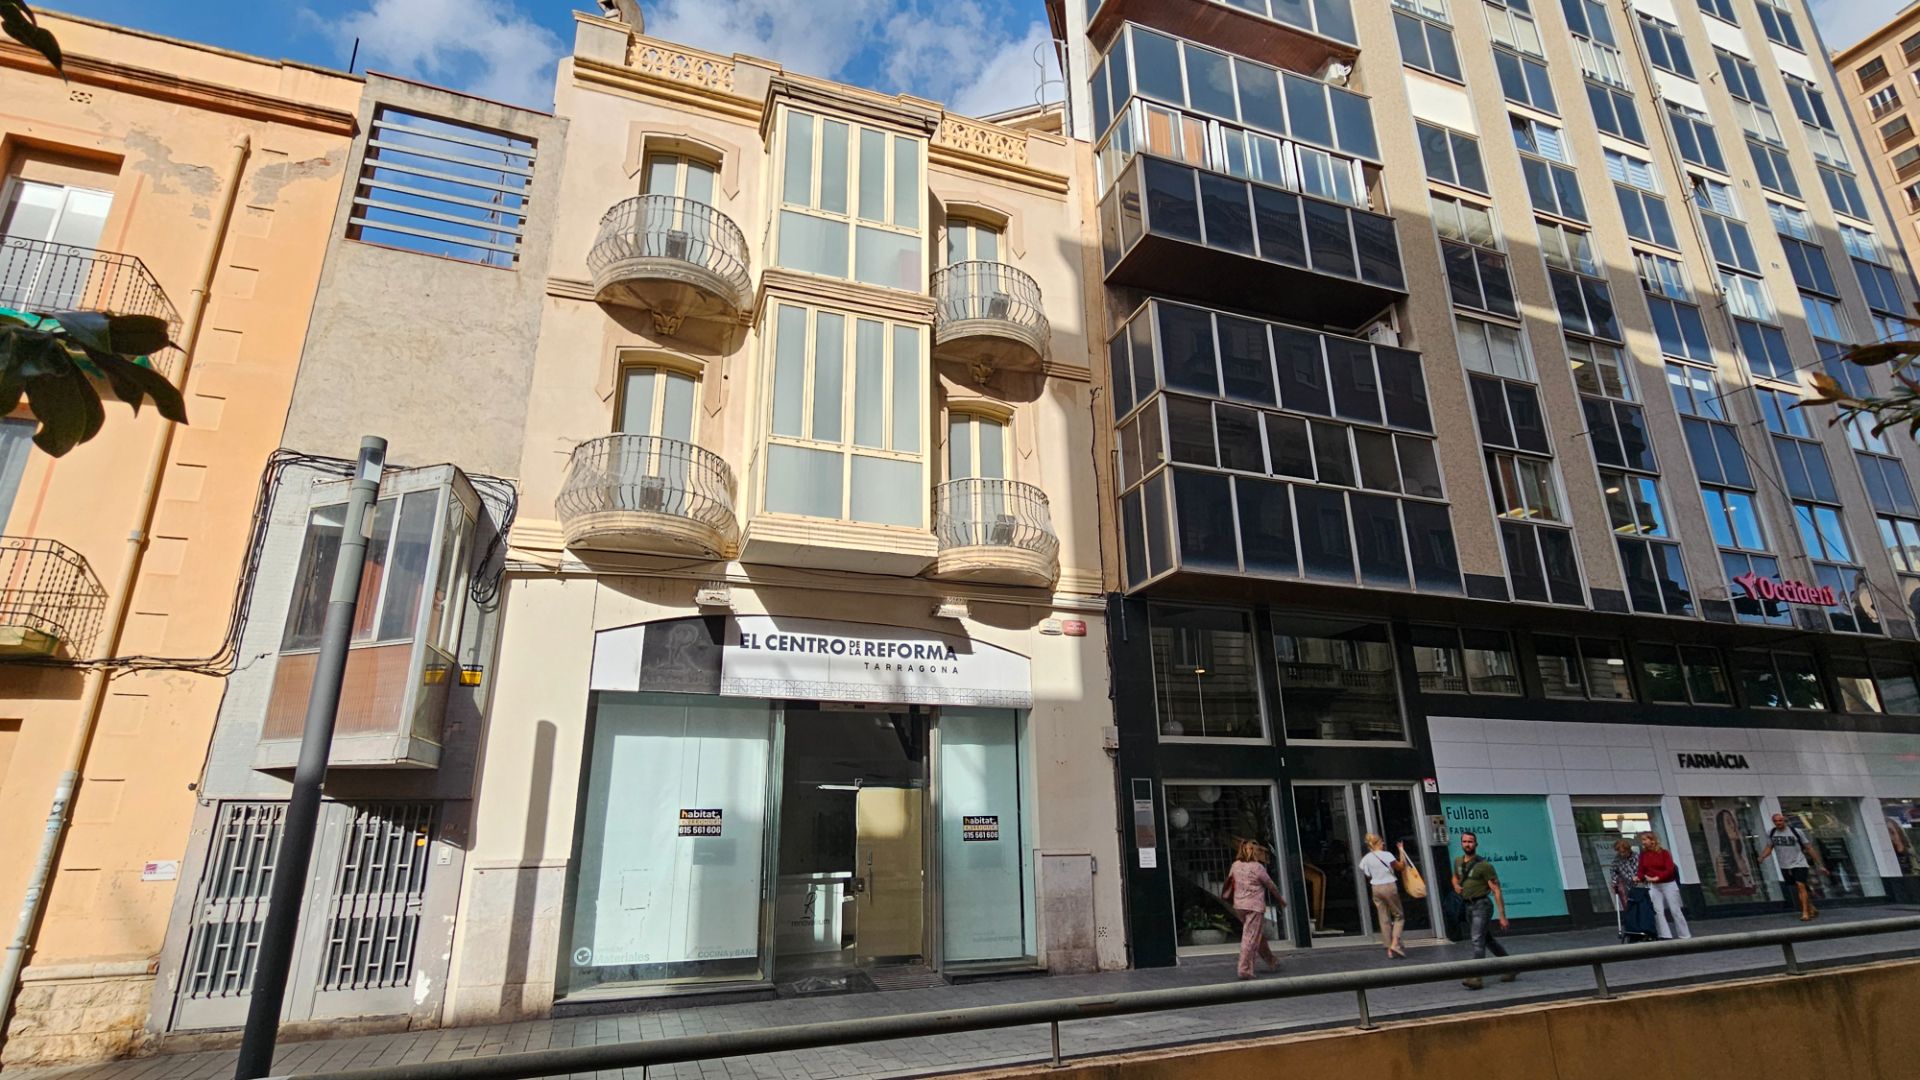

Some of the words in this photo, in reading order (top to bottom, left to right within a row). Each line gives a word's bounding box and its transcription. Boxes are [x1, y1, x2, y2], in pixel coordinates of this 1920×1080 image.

[1755, 576, 1837, 606] Occident
[740, 633, 761, 650] EL
[765, 634, 846, 655] CENTRO
[849, 640, 861, 648] DE
[849, 648, 861, 656] LA
[864, 641, 958, 661] REFORMA
[864, 662, 959, 674] TARRAGONA
[1677, 751, 1750, 769] FARMÀCIA
[681, 810, 717, 819] habitat
[1446, 806, 1490, 820] Fullana
[965, 816, 994, 825] habitat
